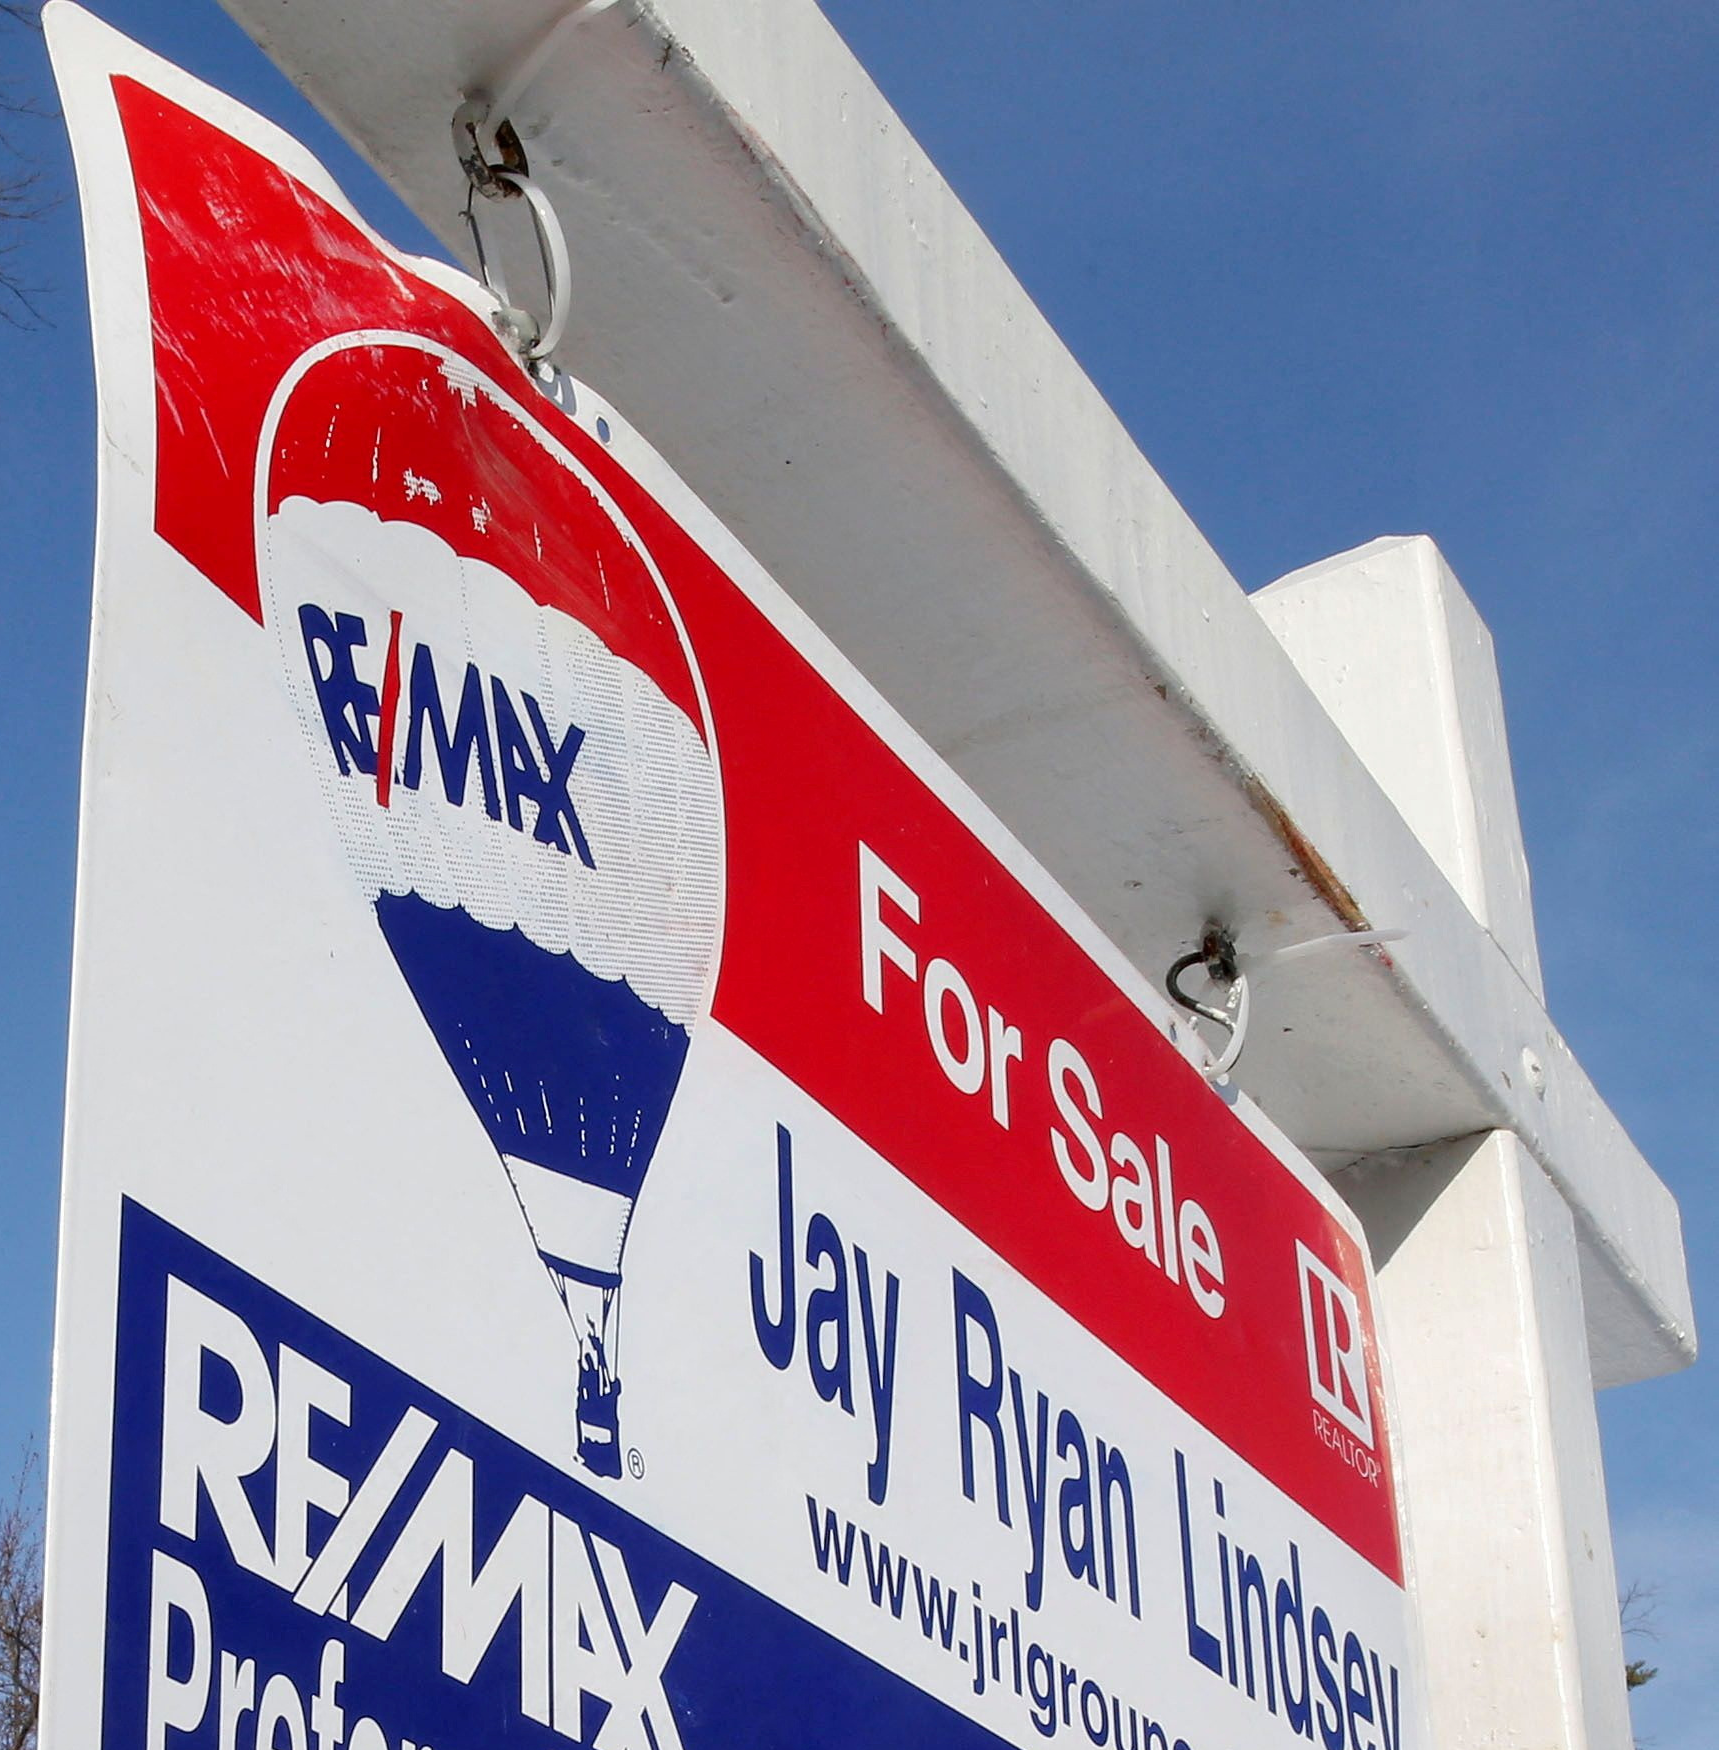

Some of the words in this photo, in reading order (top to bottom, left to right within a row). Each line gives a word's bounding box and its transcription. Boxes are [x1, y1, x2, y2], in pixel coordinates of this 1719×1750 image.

[299, 602, 596, 870] RE/MAX
[857, 840, 1023, 1130] For
[1047, 1037, 1226, 1319] Sale
[750, 1121, 900, 1505] Jay
[952, 1266, 1142, 1621] Ryan
